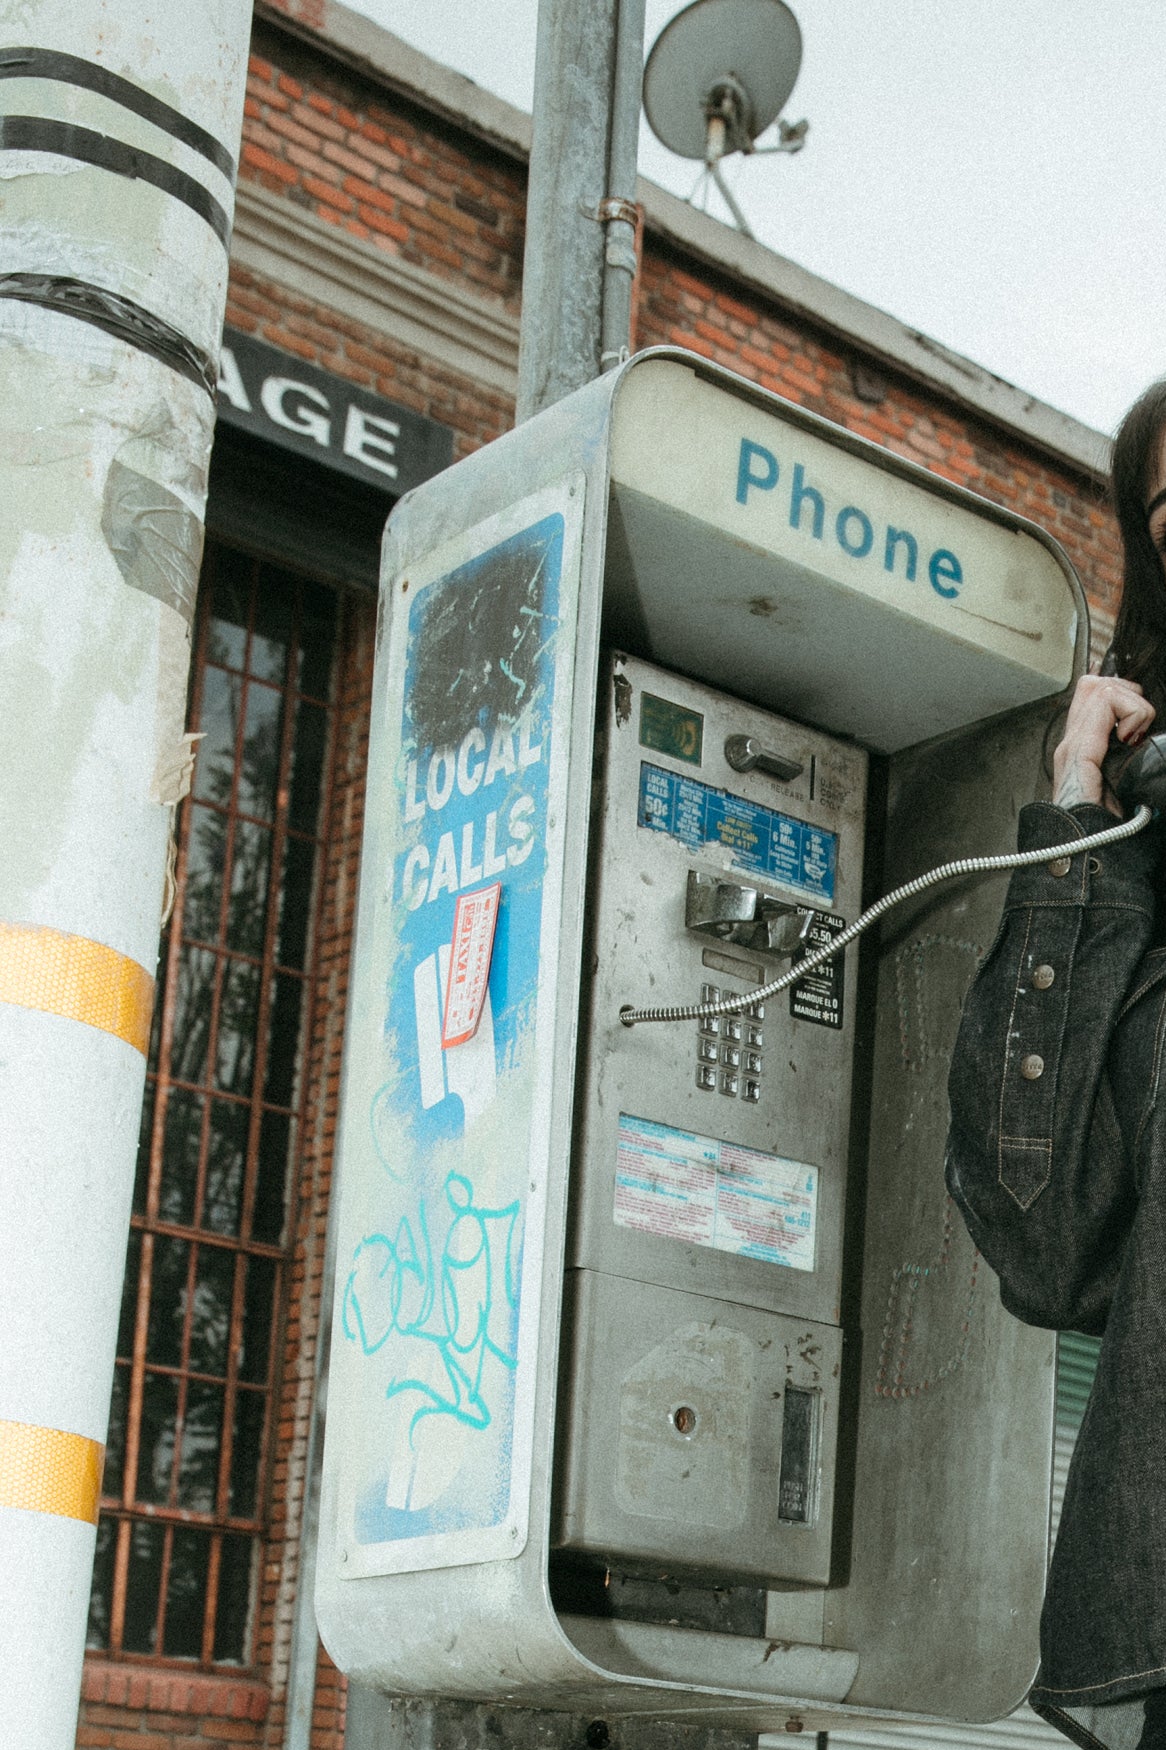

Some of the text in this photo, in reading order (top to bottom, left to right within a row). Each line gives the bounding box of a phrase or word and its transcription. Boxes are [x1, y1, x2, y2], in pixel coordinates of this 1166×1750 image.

[736, 437, 963, 599] Phone
[404, 711, 542, 824] LOCAL
[647, 773, 668, 788] LOCAL
[646, 783, 668, 798] CALLS
[401, 795, 535, 911] CALLS
[824, 913, 844, 929] CALLS
[796, 990, 824, 1005] MARQUE
[824, 997, 832, 1007] EL
[794, 1004, 822, 1019] MARQUE
